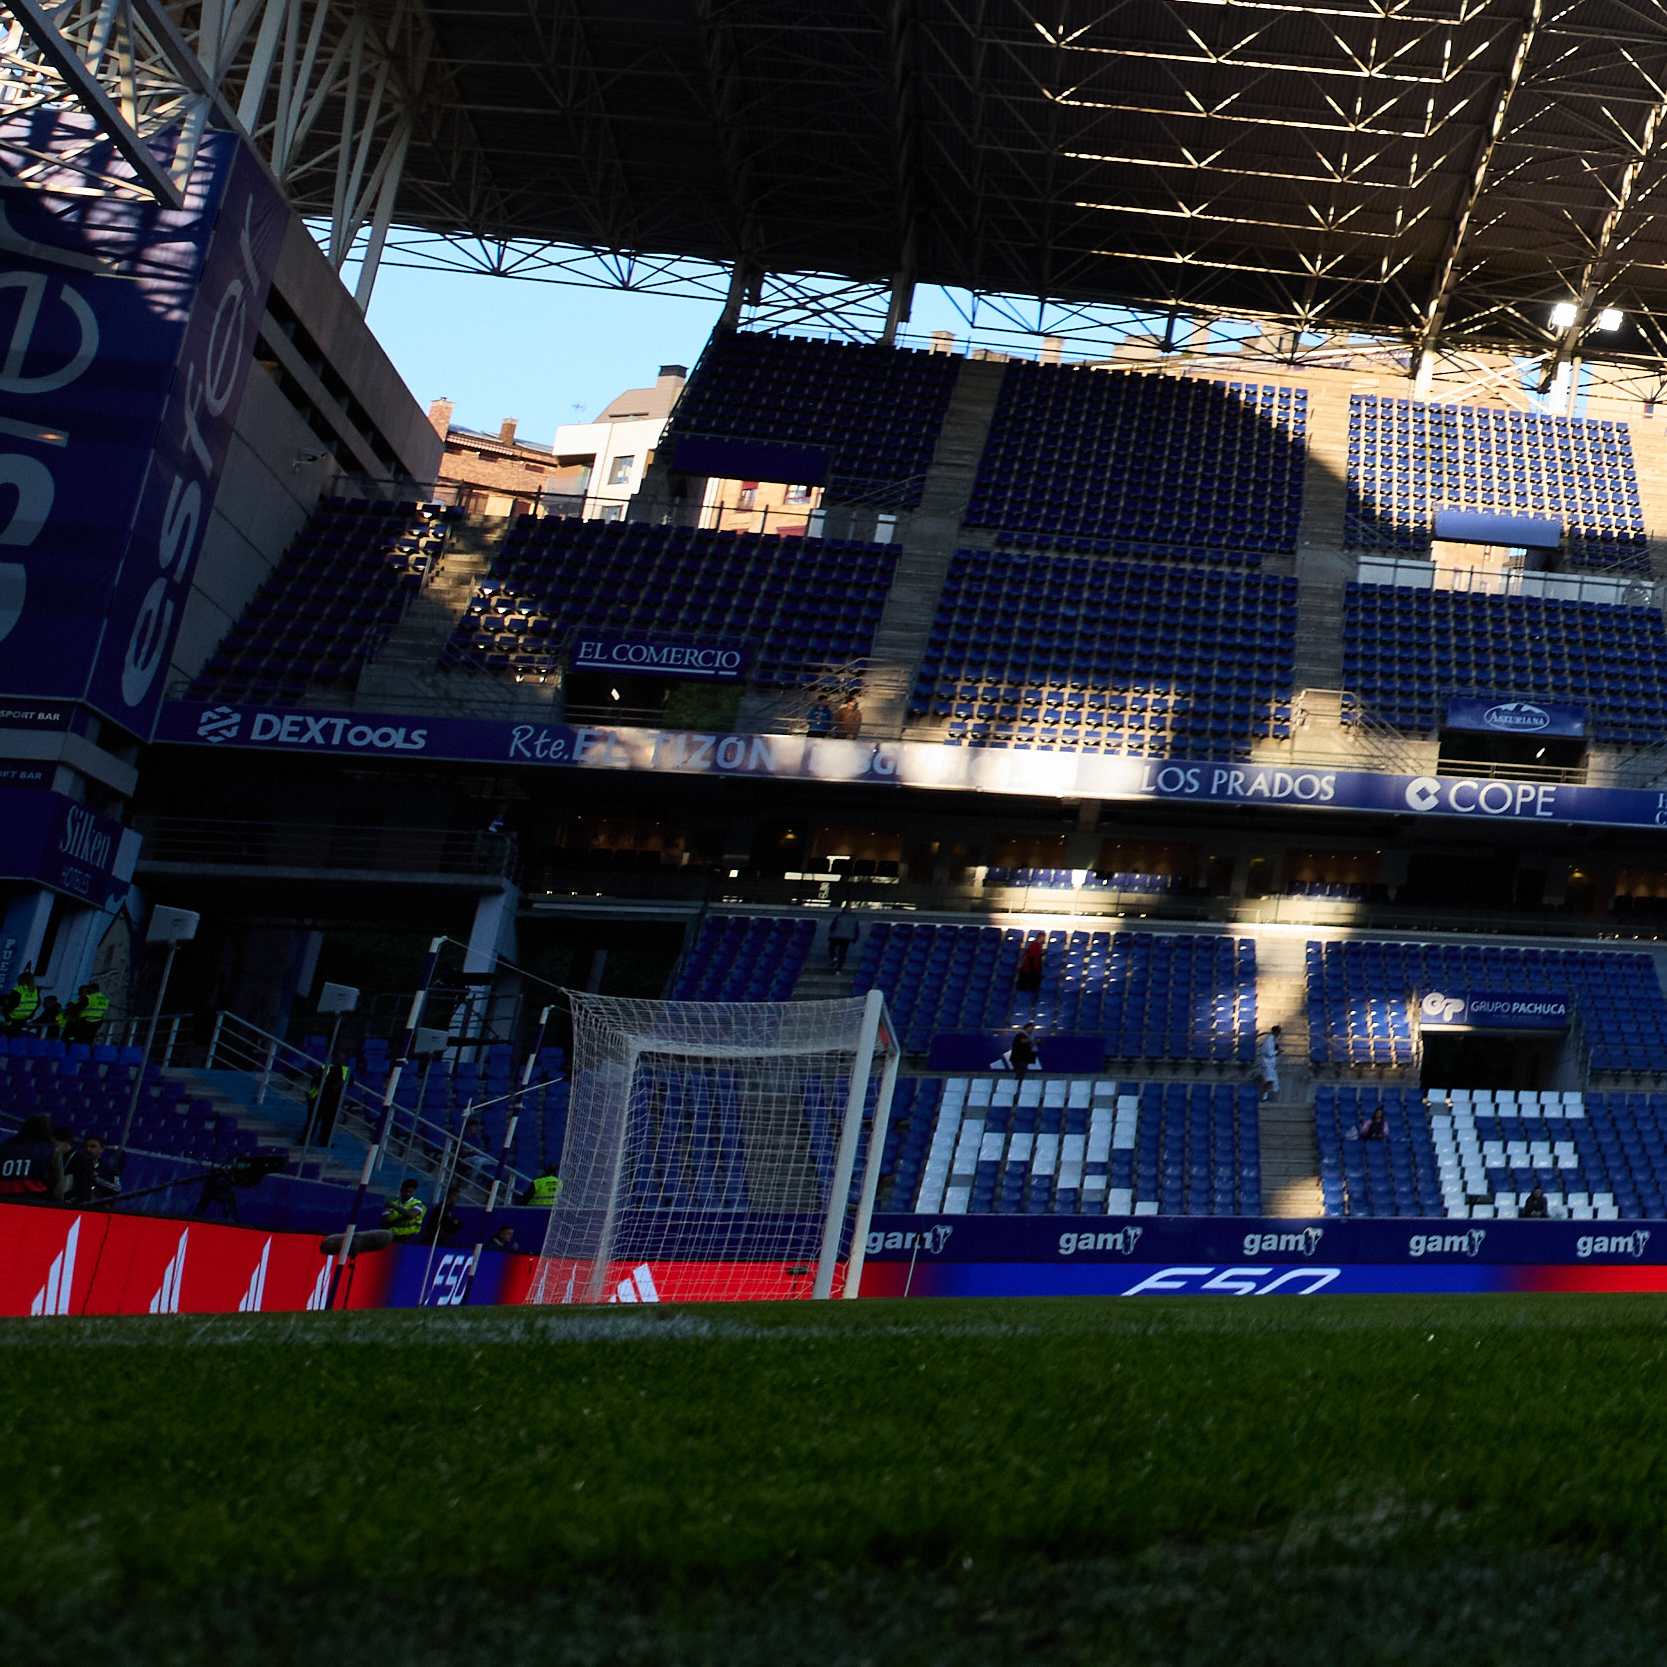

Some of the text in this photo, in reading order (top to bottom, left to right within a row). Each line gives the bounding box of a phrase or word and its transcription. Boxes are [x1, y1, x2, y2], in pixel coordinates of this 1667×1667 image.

[578, 641, 741, 668] EL COMERCIO
[37, 712, 60, 721] BAR
[509, 725, 569, 761] Rte.
[19, 771, 42, 780] BAR
[1140, 765, 1200, 794] LOS
[1211, 769, 1336, 801] PRADOS
[1449, 780, 1557, 817] COPE
[60, 805, 111, 869] Silken
[1470, 1000, 1566, 1015] GRUPO PACHUCA
